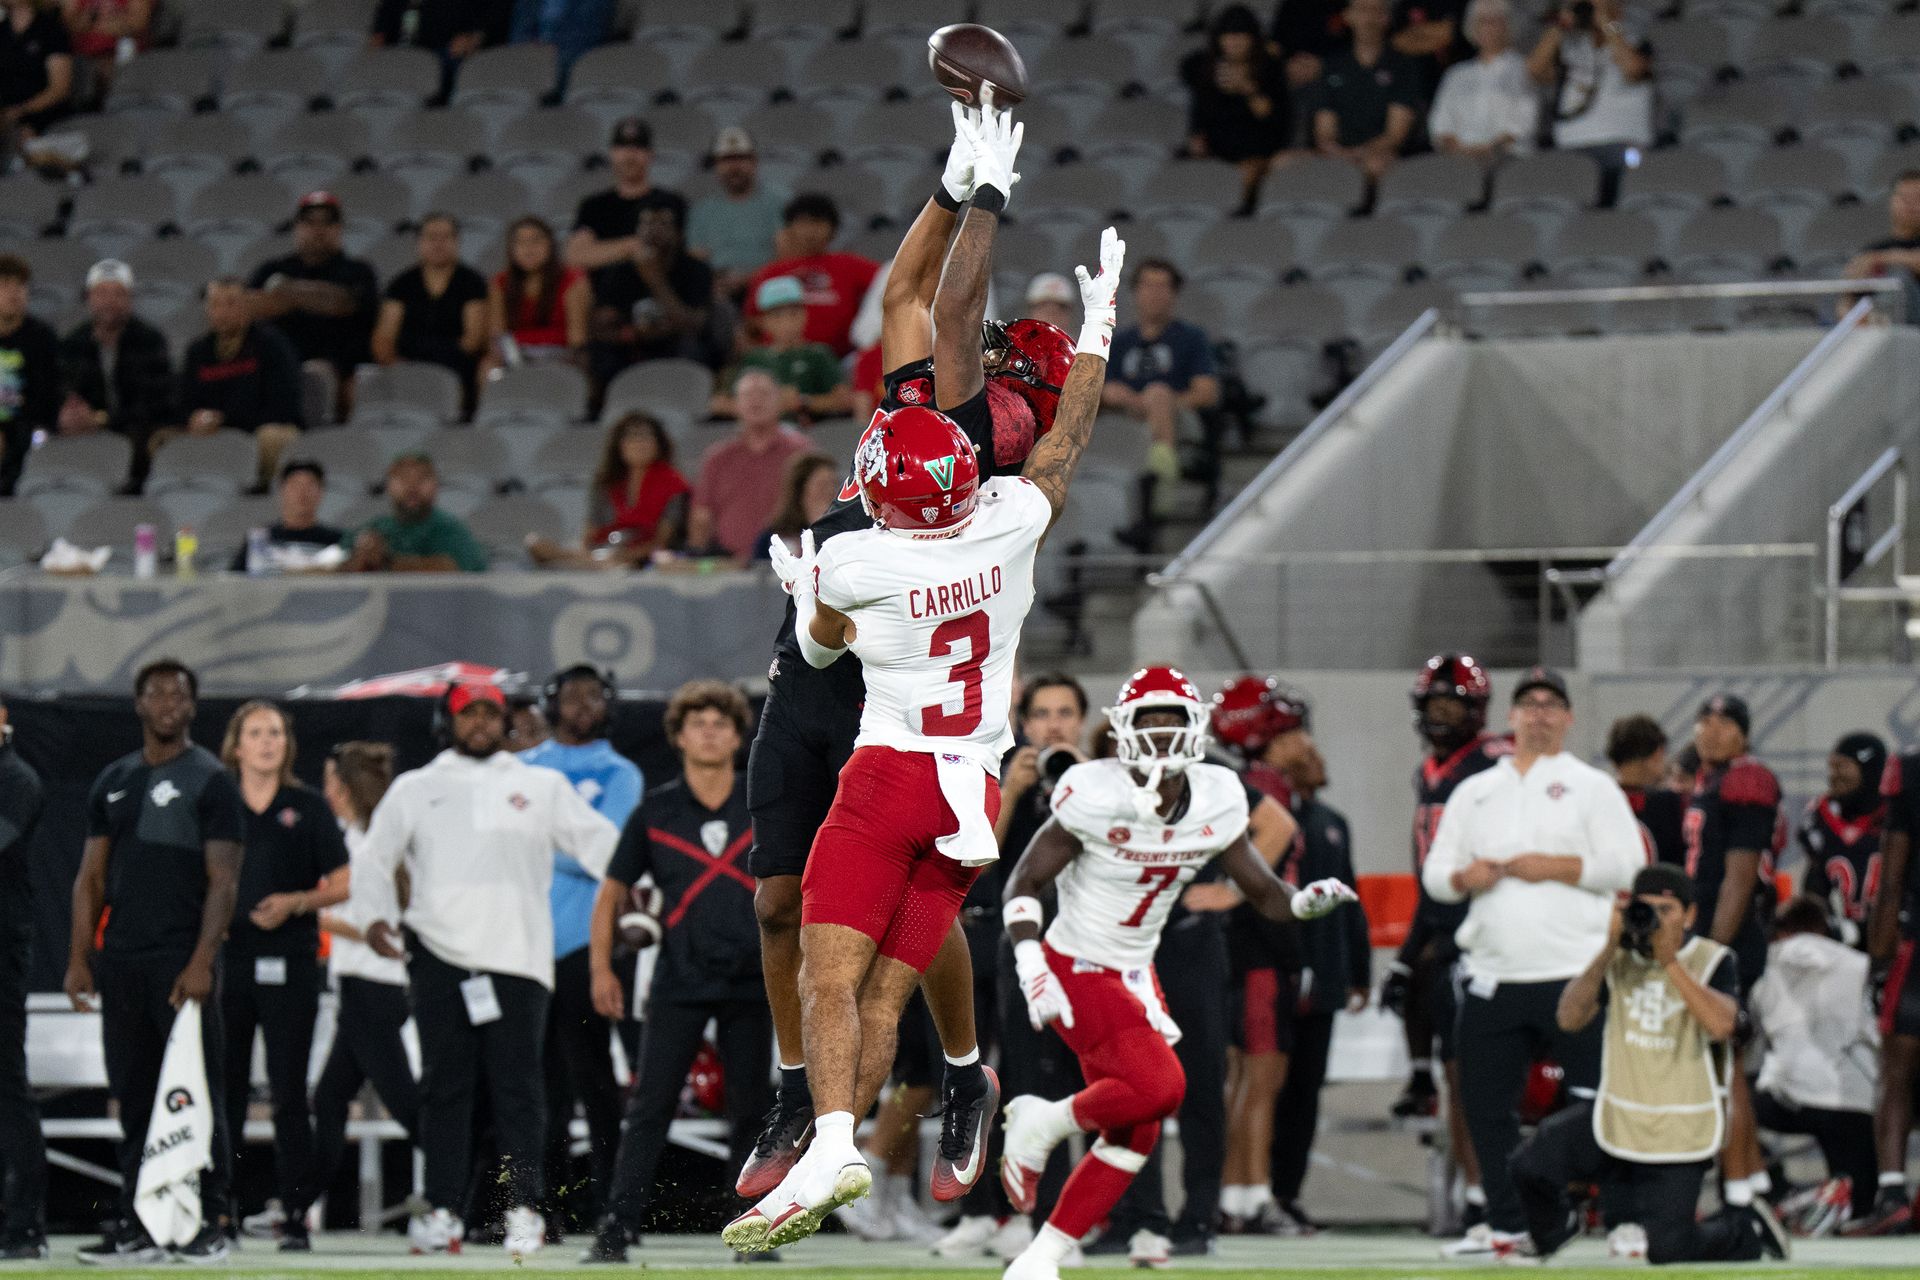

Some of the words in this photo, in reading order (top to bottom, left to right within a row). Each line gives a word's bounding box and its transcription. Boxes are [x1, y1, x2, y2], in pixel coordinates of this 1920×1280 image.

[923, 455, 956, 491] V
[942, 494, 952, 507] 3
[909, 565, 1001, 619] CARRILLO
[921, 608, 991, 737] 3
[1118, 866, 1180, 928] 7
